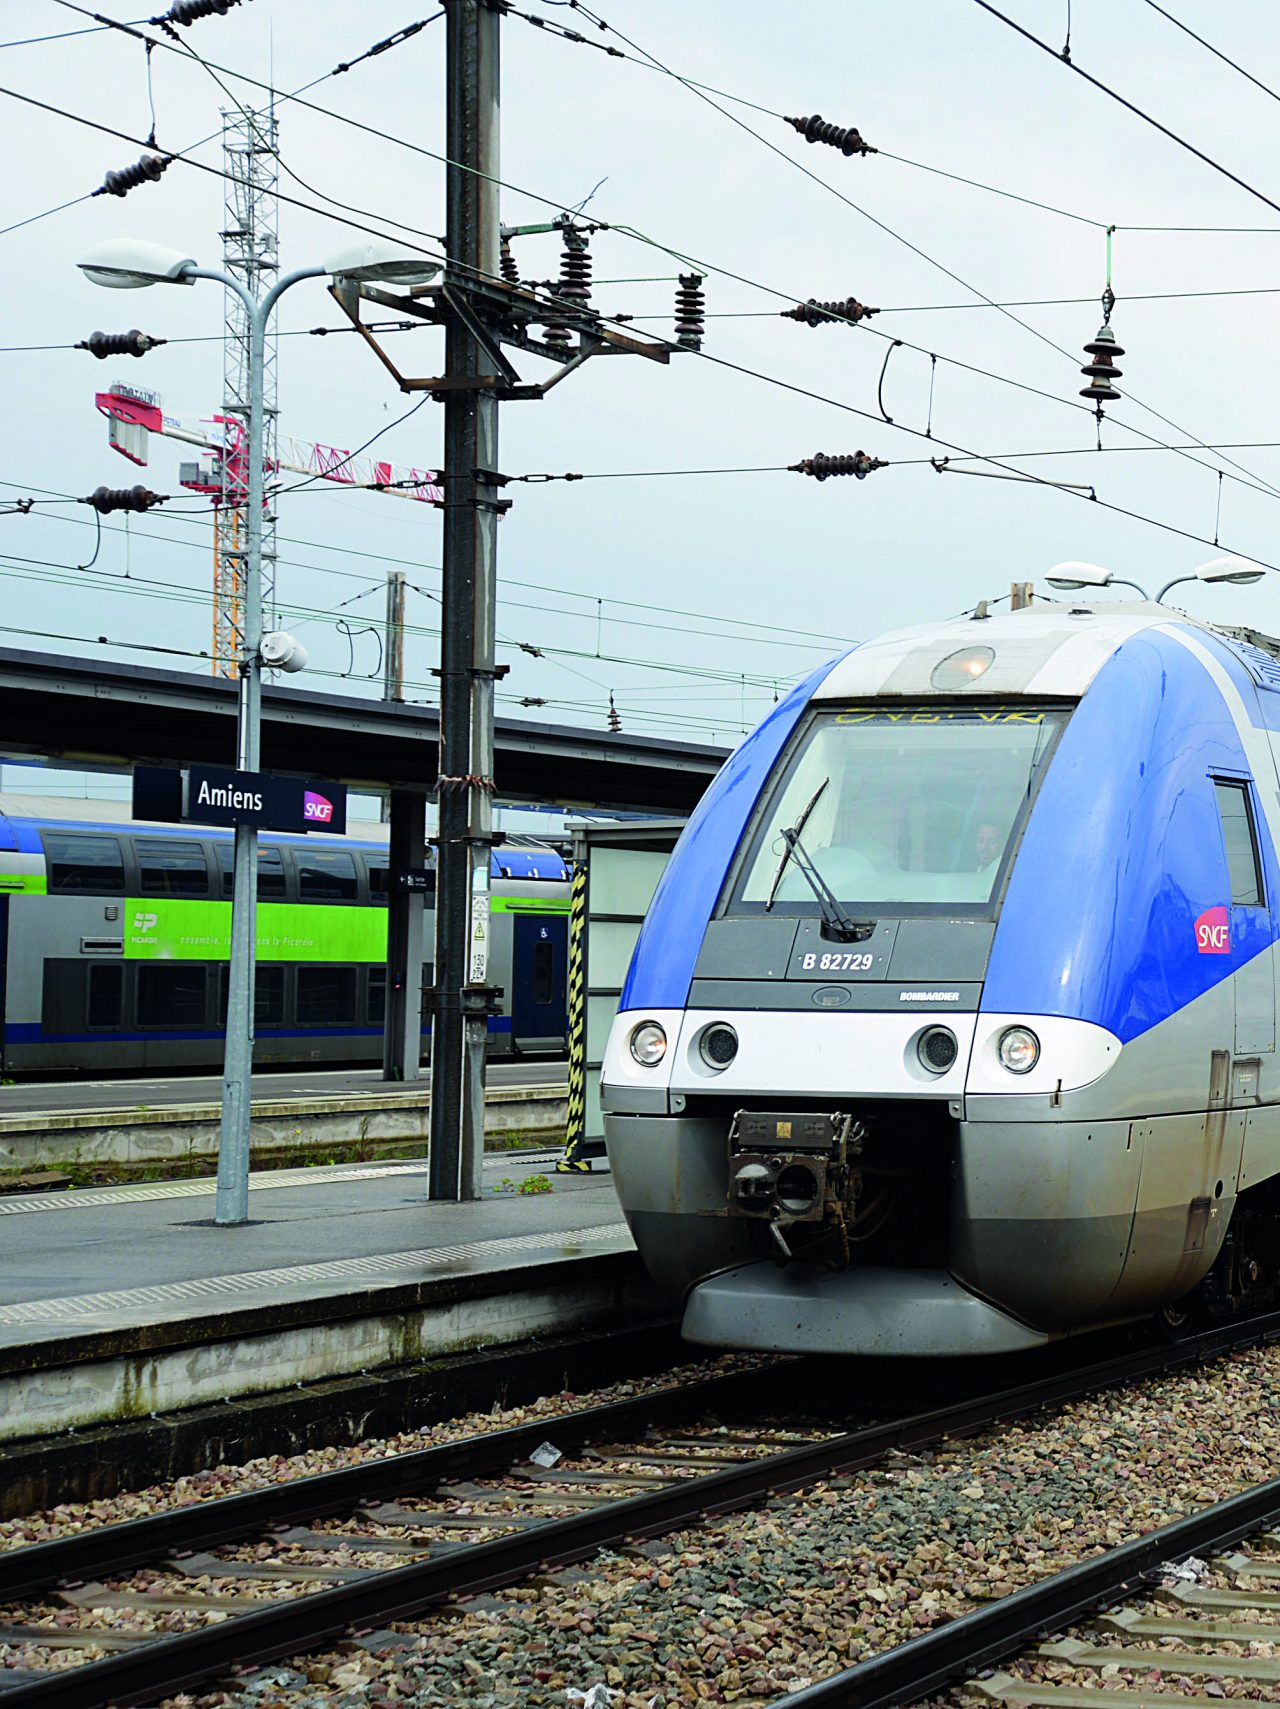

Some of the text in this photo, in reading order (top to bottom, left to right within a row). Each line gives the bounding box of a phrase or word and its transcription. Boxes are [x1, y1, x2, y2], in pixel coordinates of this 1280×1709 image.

[197, 780, 263, 811] Amiens
[304, 802, 331, 818] SNCF
[1199, 925, 1229, 947] SNCF
[803, 953, 873, 971] B 82729
[899, 991, 960, 1002] BOMBARDIER
